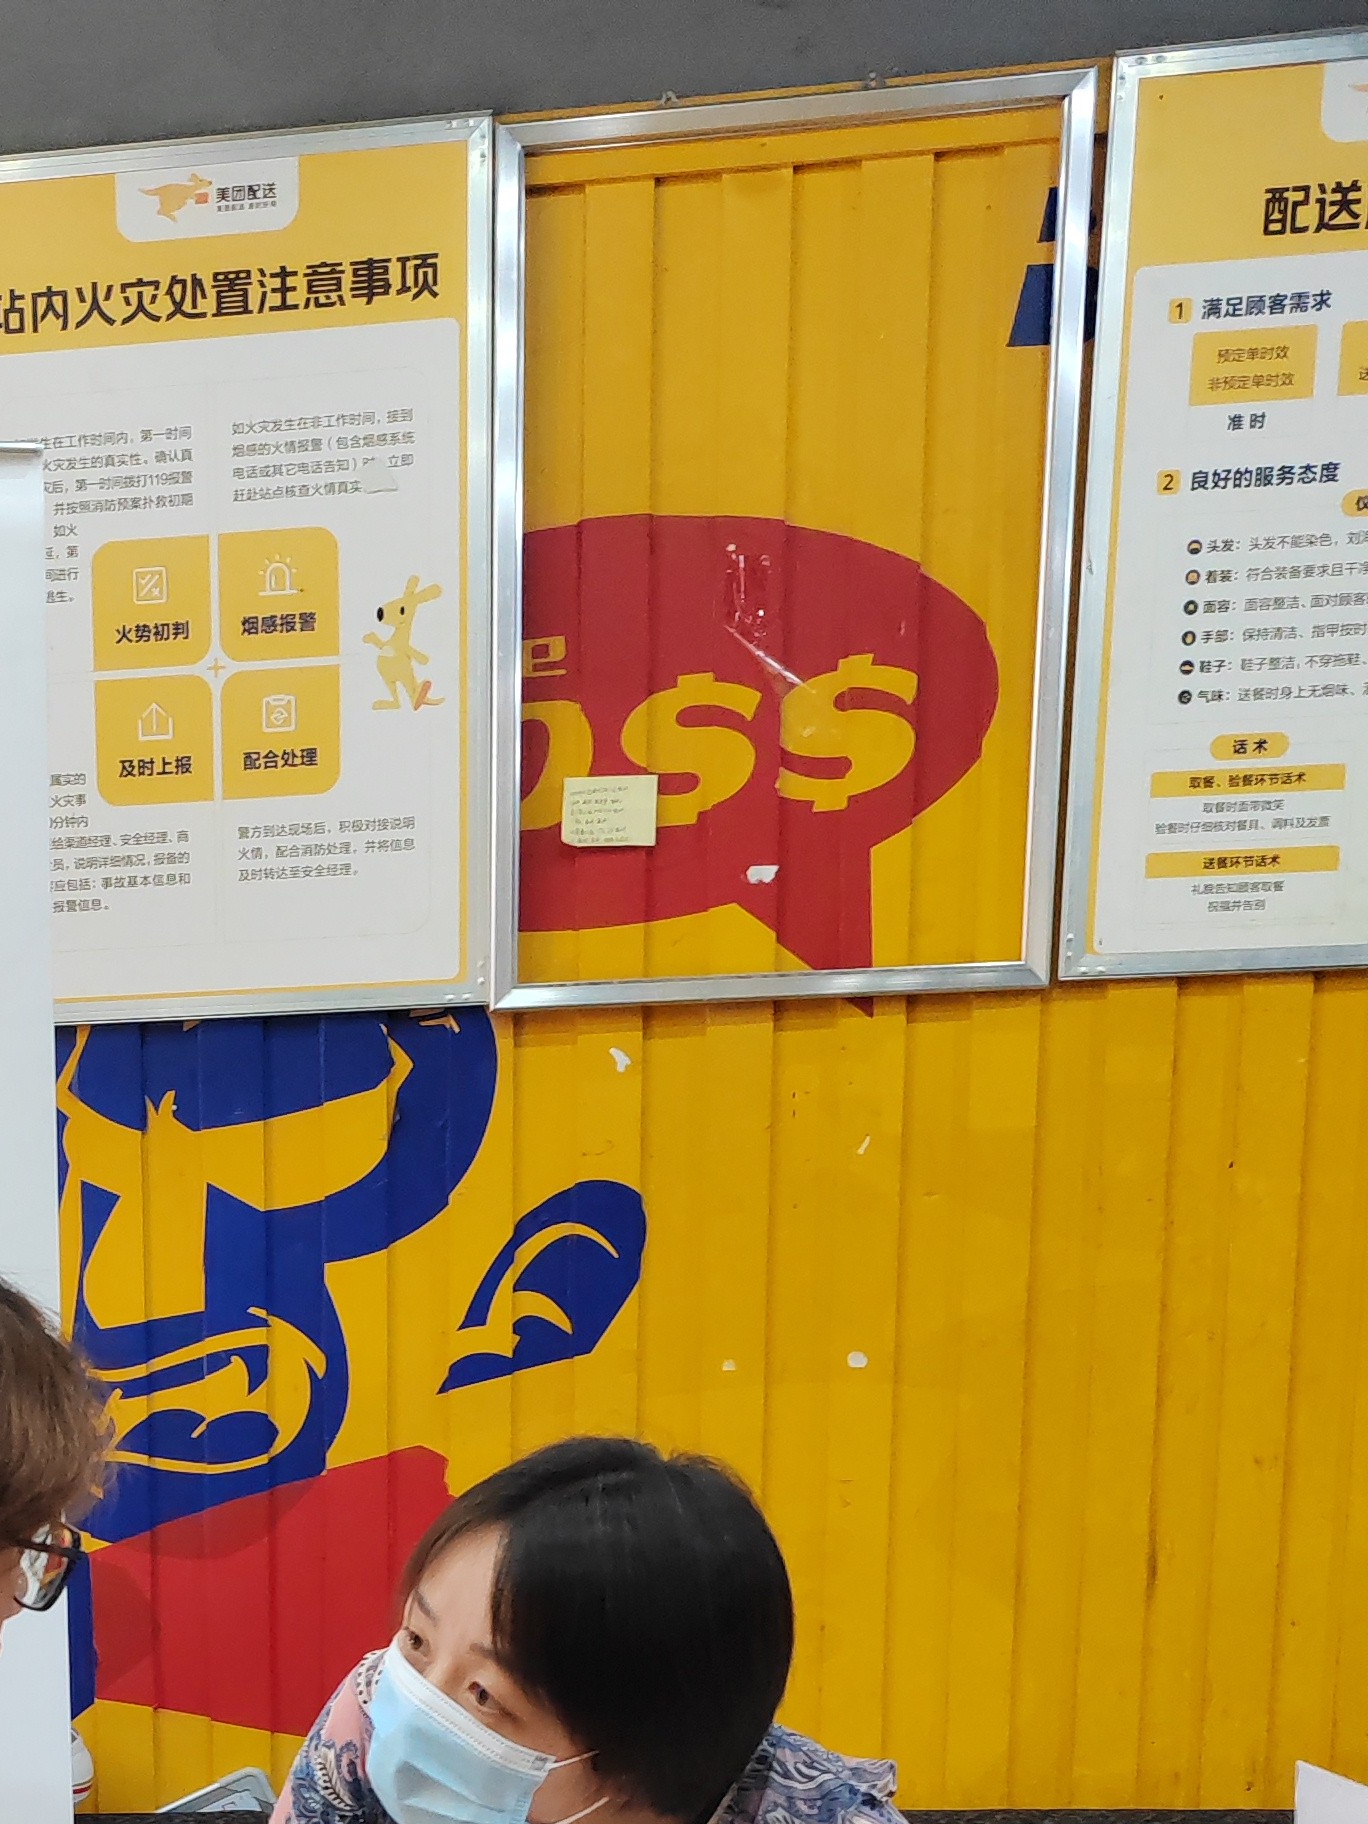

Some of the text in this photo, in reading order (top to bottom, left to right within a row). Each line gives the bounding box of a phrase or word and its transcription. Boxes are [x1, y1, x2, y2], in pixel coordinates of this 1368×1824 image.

[1263, 179, 1368, 236] 配送
[1175, 289, 1332, 321] 1 满足顾客需求
[1227, 412, 1267, 431] 准时
[1162, 461, 1341, 492] 2 良好的服务态度
[114, 620, 190, 644] 火势初判
[240, 611, 318, 636] 烟感报警
[242, 746, 319, 771] 配合处理
[1232, 738, 1269, 755] 话术
[118, 755, 193, 778] 及时上报
